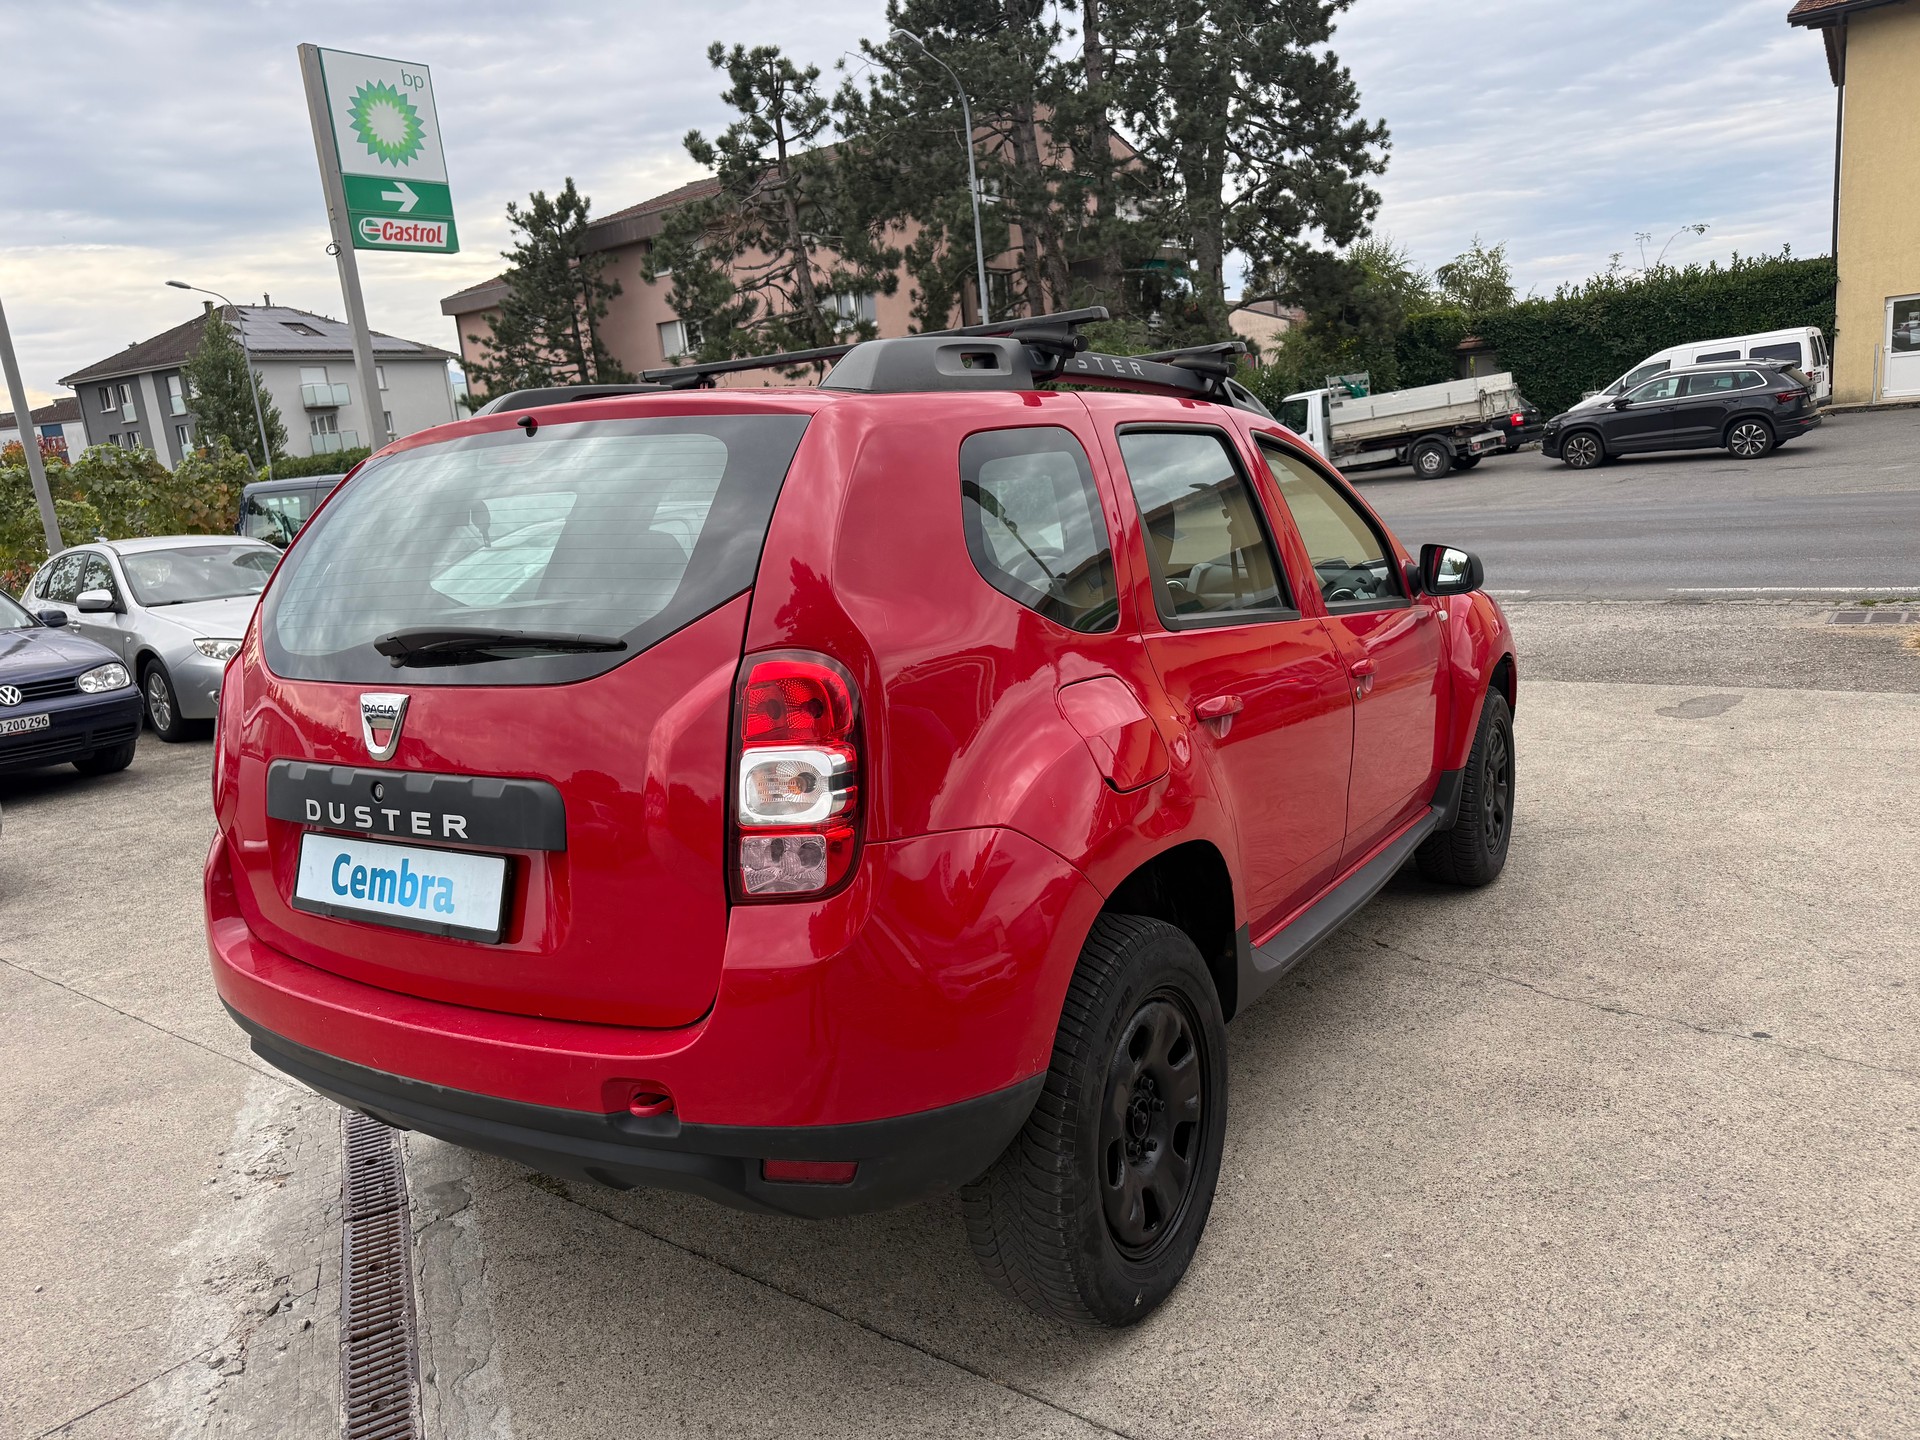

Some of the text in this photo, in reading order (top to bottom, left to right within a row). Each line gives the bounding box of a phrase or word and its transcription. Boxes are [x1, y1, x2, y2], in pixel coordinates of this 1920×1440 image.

[401, 69, 424, 92] bp
[382, 221, 443, 244] Castrol
[364, 704, 394, 714] DACIA
[28, 716, 48, 728] 296
[305, 799, 469, 839] DUSTER
[331, 853, 455, 914] Cembra
